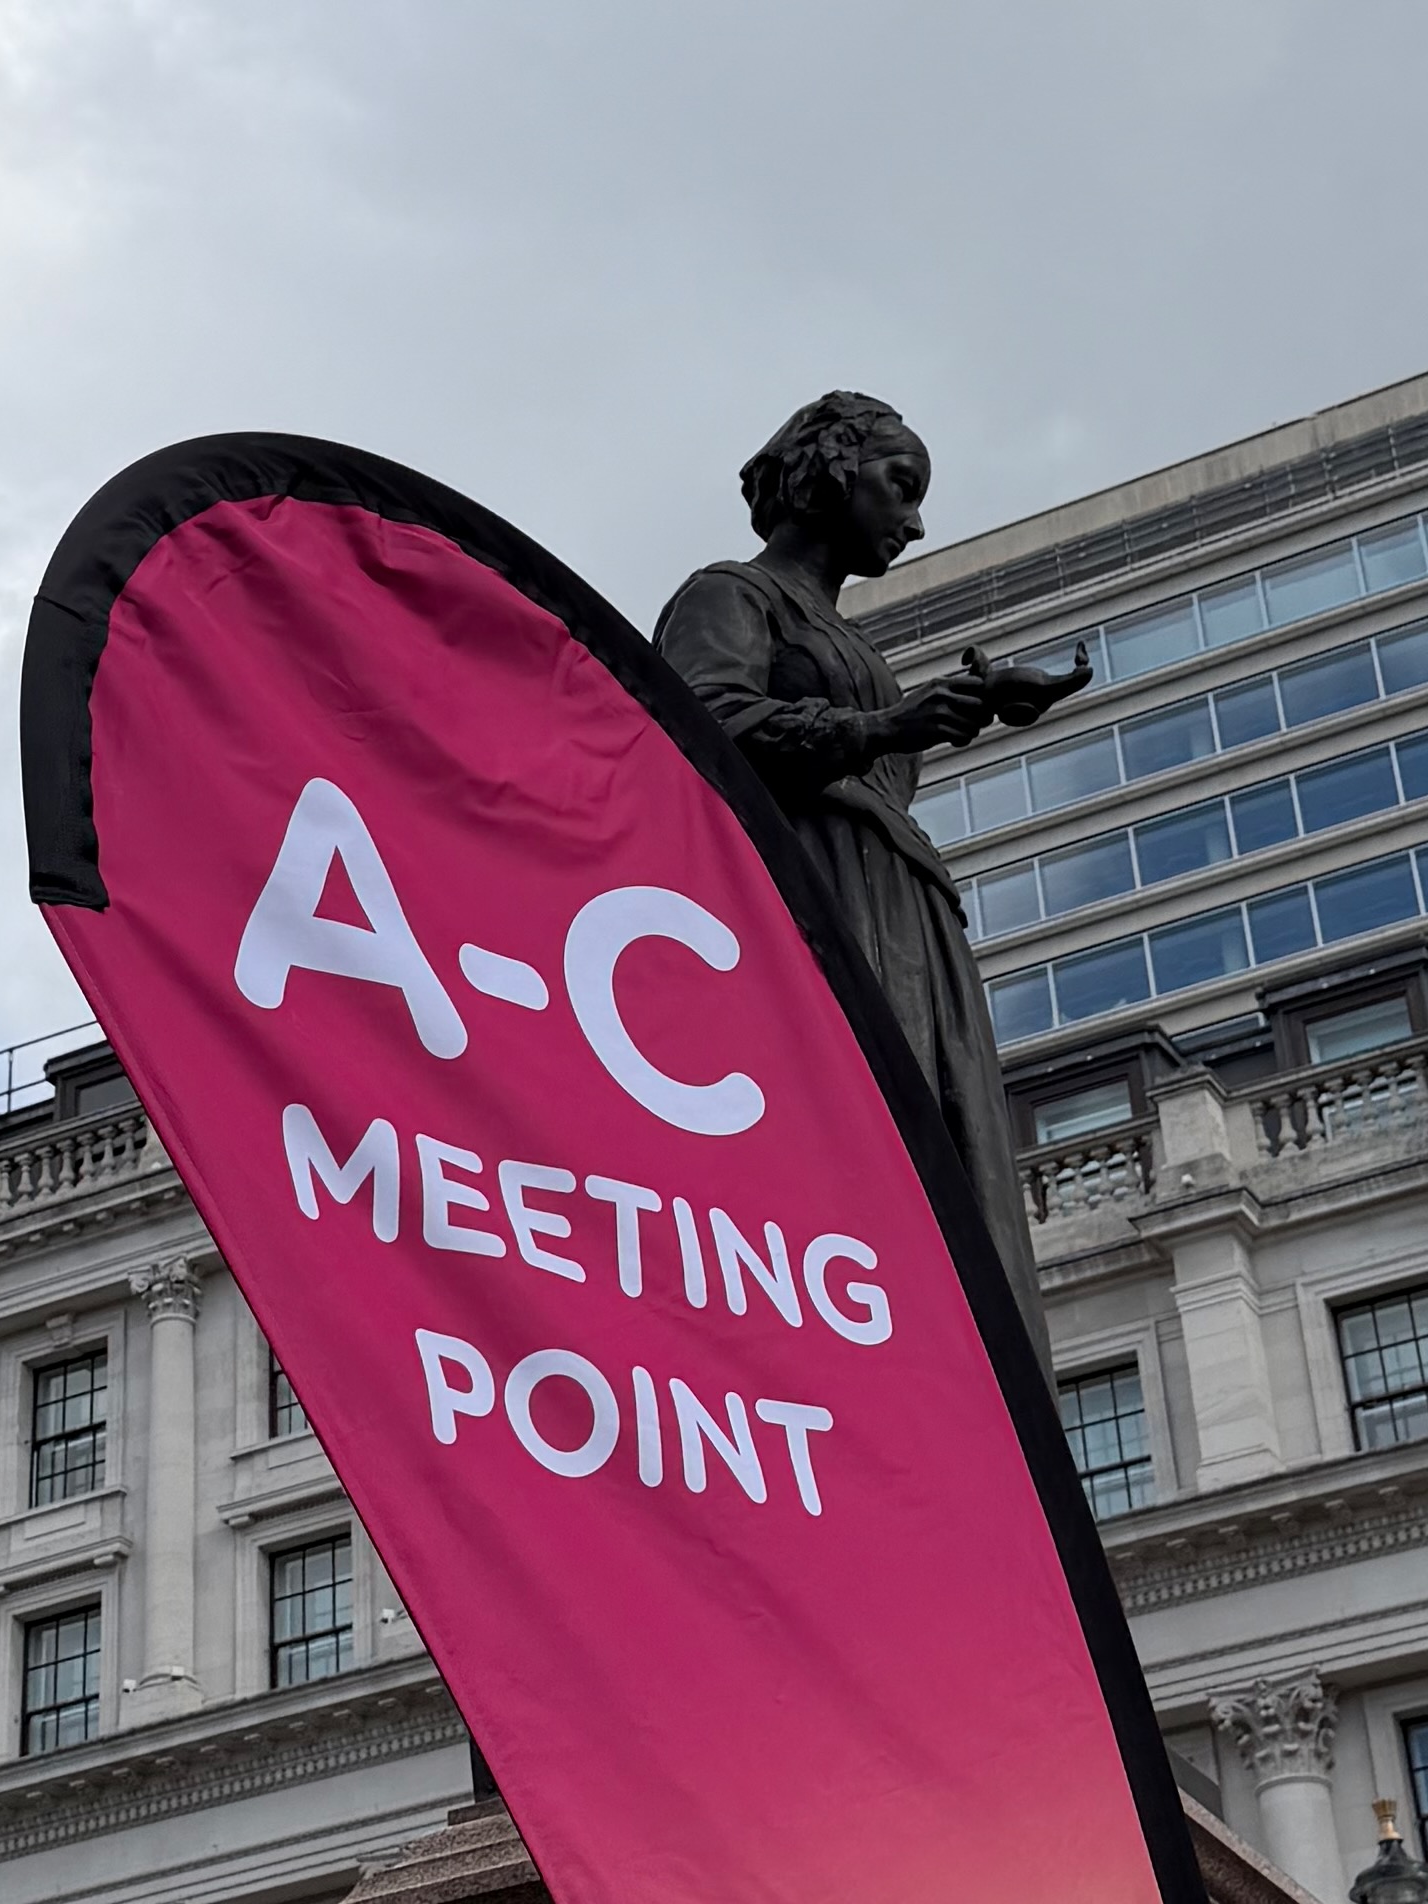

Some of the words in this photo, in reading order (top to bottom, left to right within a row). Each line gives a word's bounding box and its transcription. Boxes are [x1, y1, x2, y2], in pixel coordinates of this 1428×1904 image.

[234, 778, 764, 1135] A-C
[282, 1104, 892, 1346] MEETING
[416, 1328, 833, 1516] POINT
